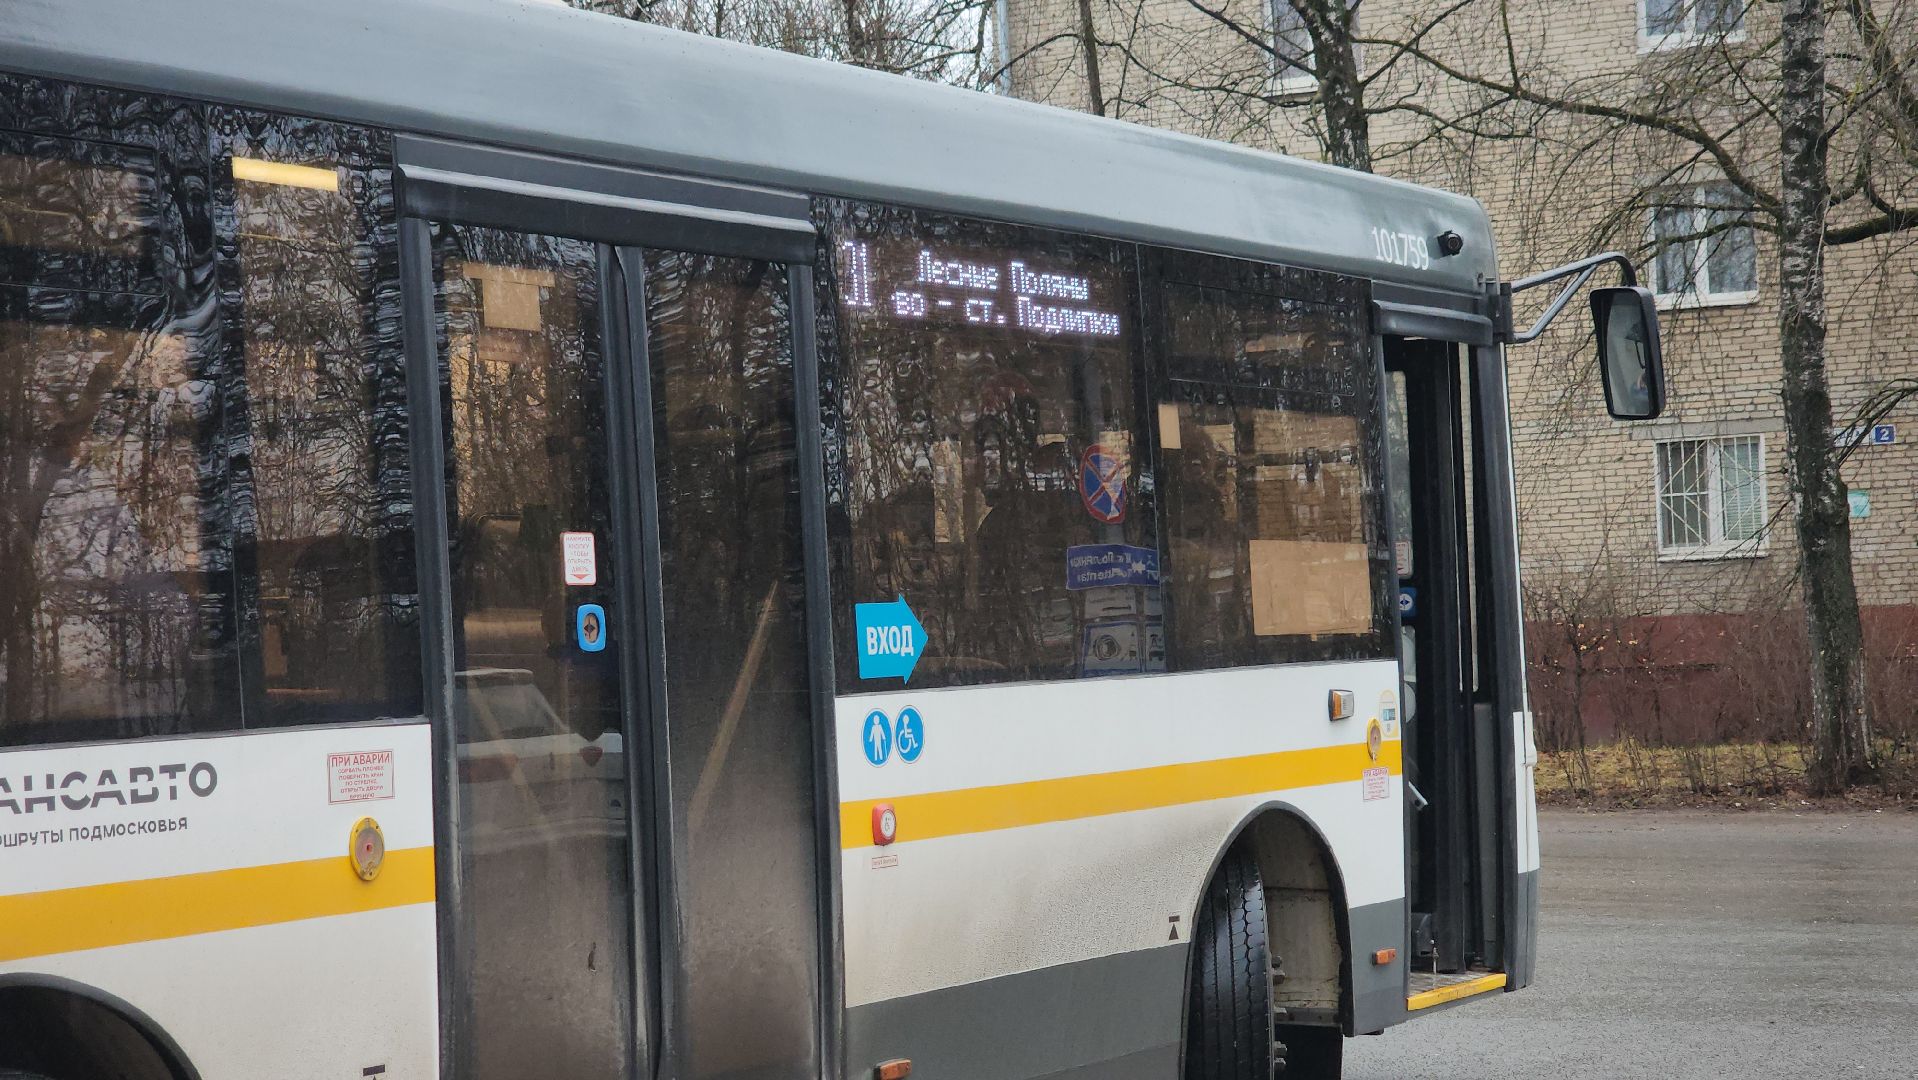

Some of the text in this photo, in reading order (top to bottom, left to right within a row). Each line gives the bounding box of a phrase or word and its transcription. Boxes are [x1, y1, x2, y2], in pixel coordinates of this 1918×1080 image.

[1371, 226, 1429, 271] 101759
[917, 249, 1089, 300] Лесные Поляны
[891, 290, 925, 317] во
[965, 299, 1007, 324] ст.
[1017, 295, 1121, 336] Подлипки
[1880, 428, 1890, 441] 2
[866, 625, 915, 657] ВХОД
[331, 753, 390, 768] ПРИ АВАРИИ
[0, 761, 218, 815] АНСАВТО
[0, 817, 188, 848] ШРУТЫ ПОДМОСКОВЬЯ
